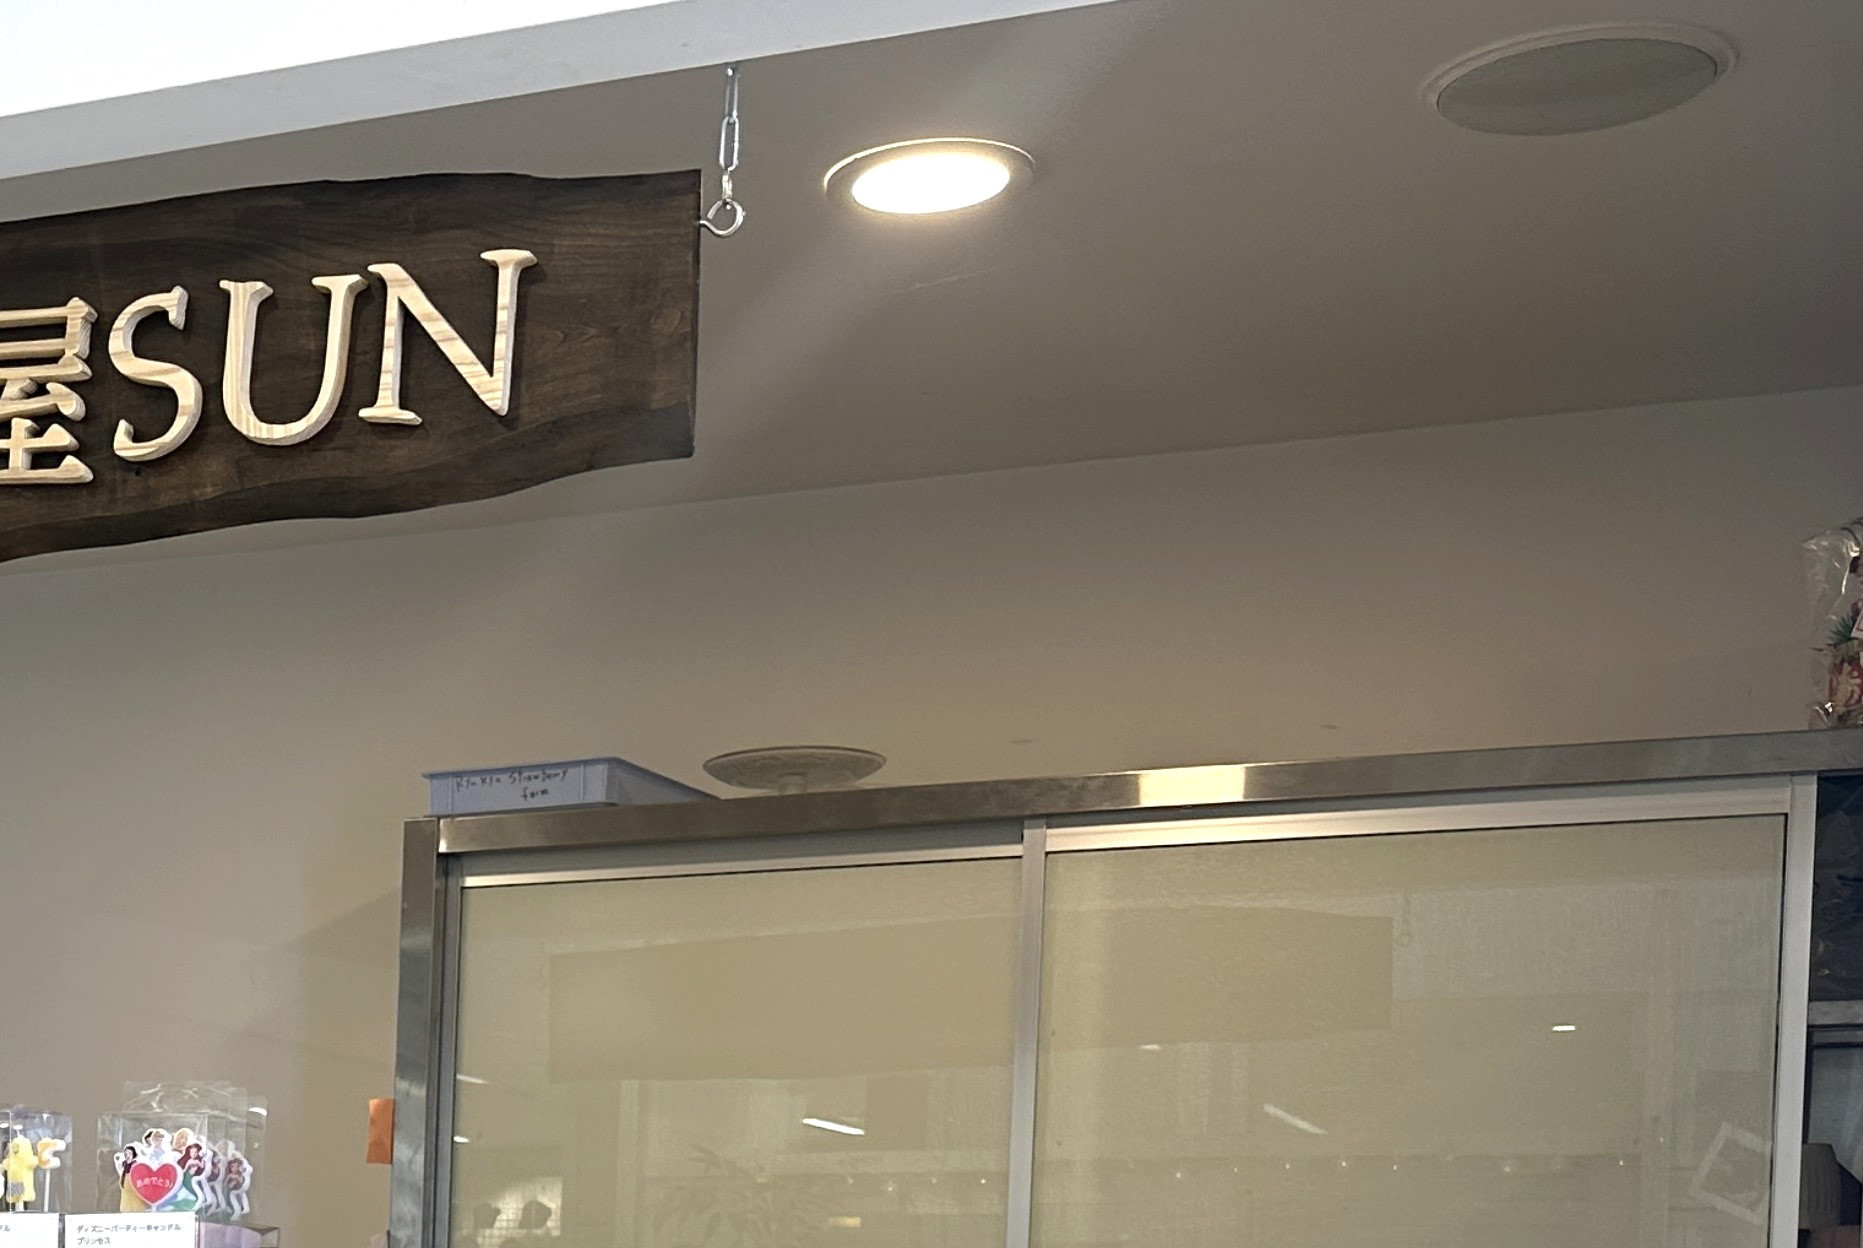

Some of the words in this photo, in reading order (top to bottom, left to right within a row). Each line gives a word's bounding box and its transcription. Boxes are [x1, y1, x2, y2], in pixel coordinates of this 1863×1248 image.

[76, 1236, 111, 1246] プリンセス
